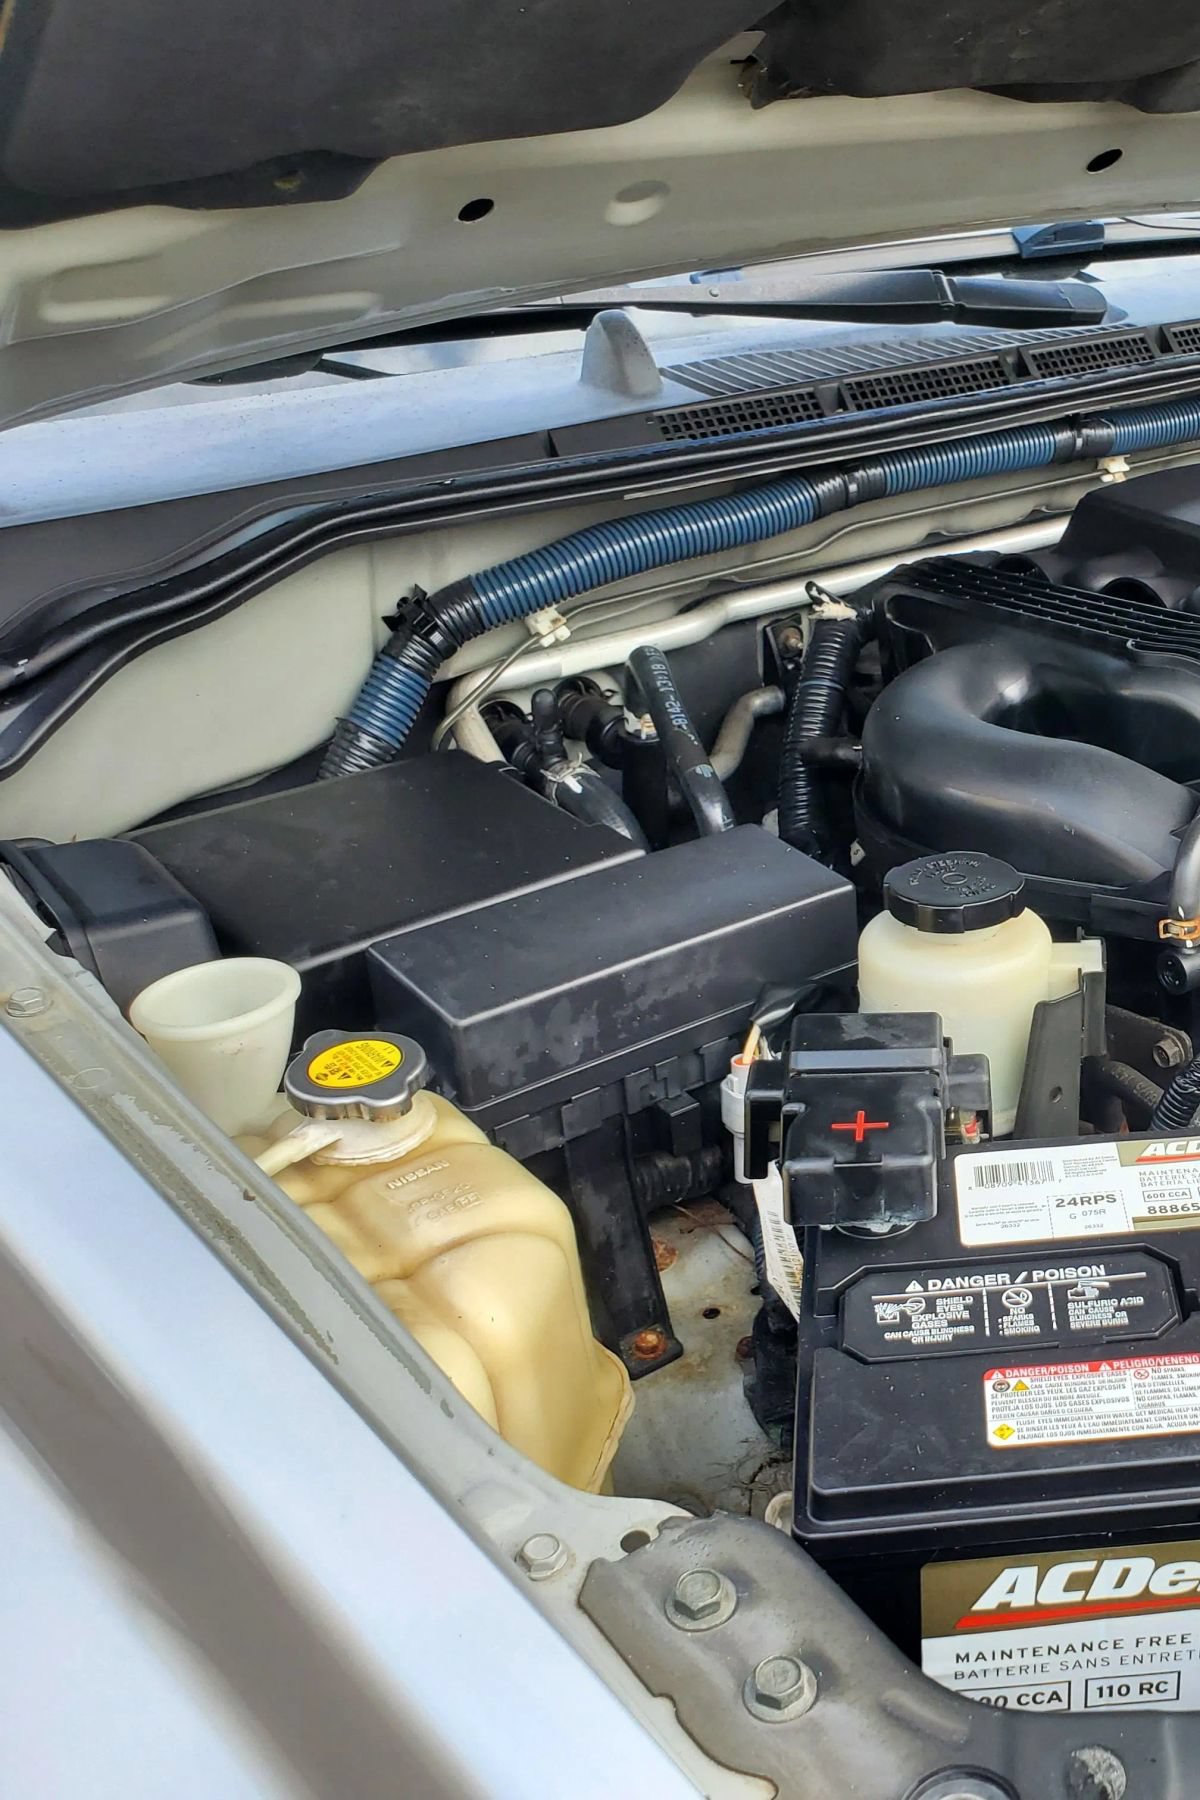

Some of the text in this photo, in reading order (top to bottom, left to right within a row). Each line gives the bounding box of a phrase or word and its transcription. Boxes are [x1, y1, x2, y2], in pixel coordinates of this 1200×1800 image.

[387, 1160, 450, 1189] NISSAN
[1139, 1172, 1188, 1183] BATTERIE
[1055, 1193, 1118, 1208] 24RPS
[1146, 1191, 1188, 1200] 600 CCA
[927, 1272, 1011, 1291] DANGER
[1032, 1264, 1106, 1282] POISON
[936, 1296, 973, 1306] SHIELD
[1067, 1296, 1144, 1309] SULFURIC ACID
[937, 1304, 964, 1313] EYES
[1010, 1307, 1025, 1315] NO
[1068, 1305, 1114, 1315] CAN CAUSE
[911, 1311, 970, 1322] EXPLOSIVE
[1003, 1314, 1034, 1322] SPARKS
[911, 1319, 948, 1329] GASES
[1003, 1320, 1034, 1328] FLAMES
[884, 1331, 901, 1340] CAN
[1003, 1325, 1040, 1335] SMOKING
[1113, 1355, 1200, 1370] PELIGRO/VENENO
[1005, 1363, 1090, 1378] DANGER/POISON
[954, 1638, 1124, 1665] MAINTENANCE
[1135, 1631, 1194, 1647] FREE
[954, 1663, 1052, 1682] BATTERIE
[1058, 1658, 1112, 1672] SANS
[1096, 1680, 1169, 1699] 110 RC
[1016, 1690, 1063, 1706] CCA
